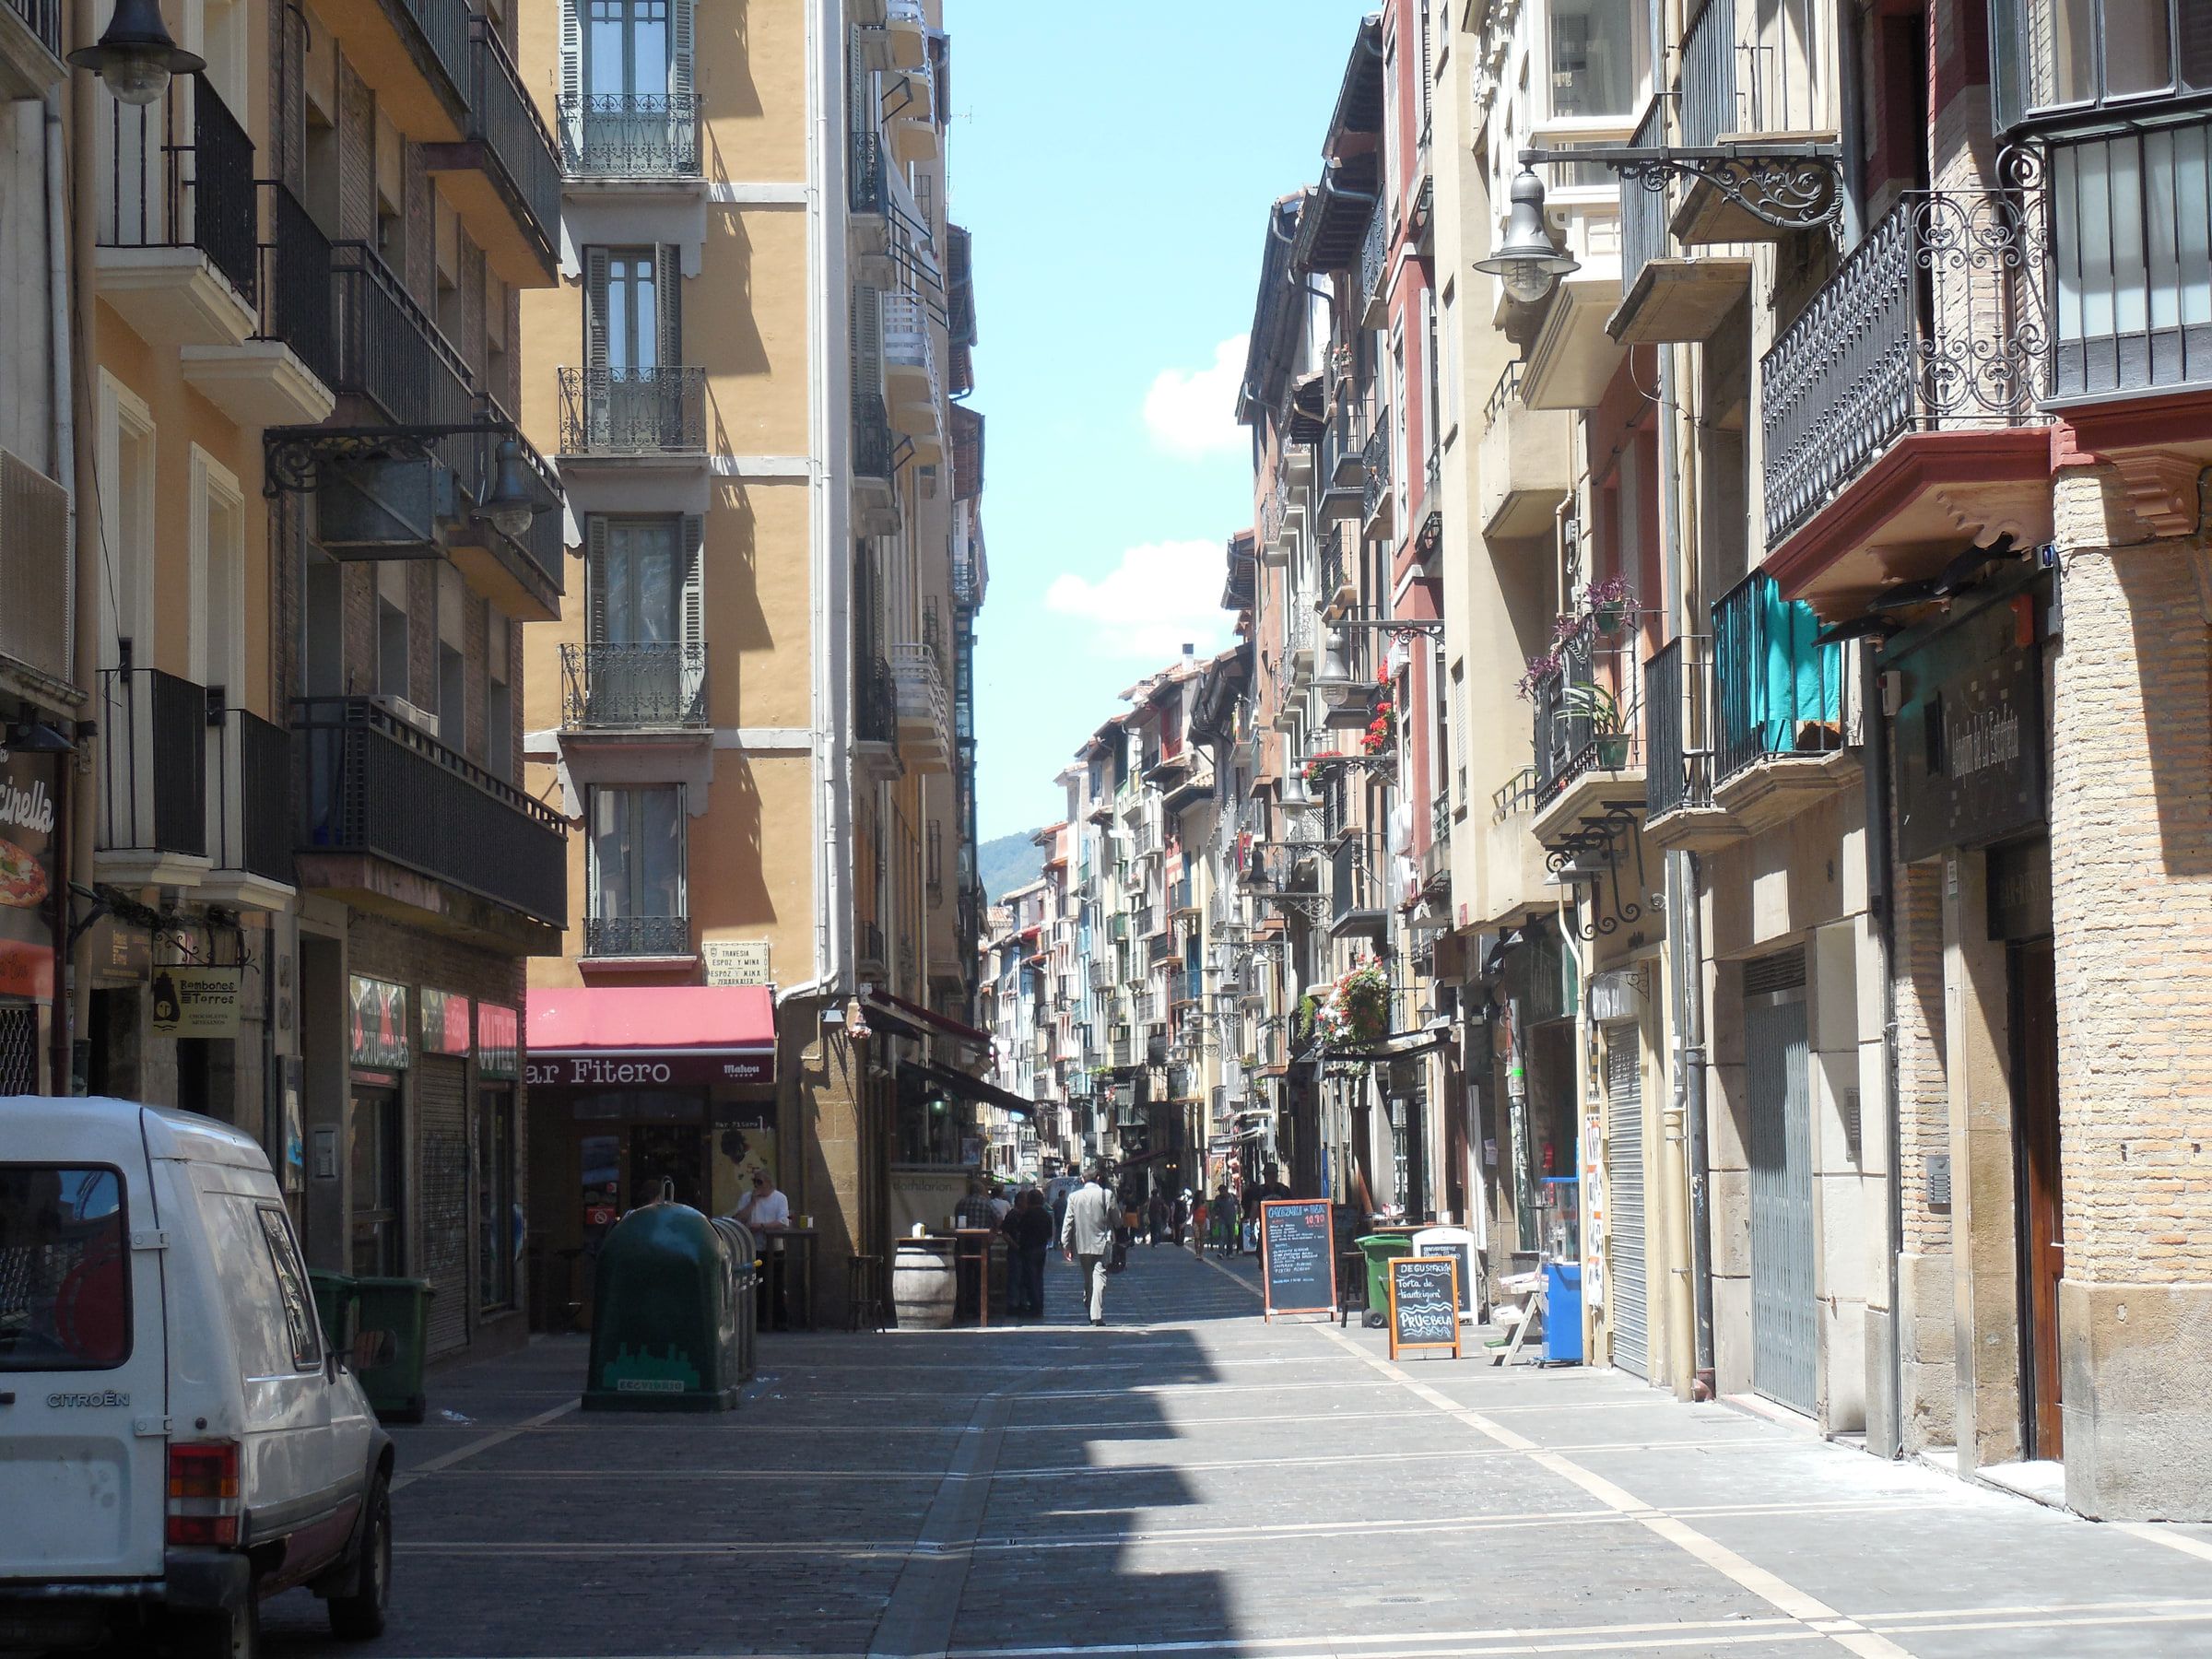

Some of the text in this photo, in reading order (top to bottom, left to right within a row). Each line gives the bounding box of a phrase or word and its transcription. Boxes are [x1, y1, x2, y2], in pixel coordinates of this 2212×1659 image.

[1989, 702, 2018, 771] Estafeta
[179, 980, 235, 991] Bombones
[194, 993, 235, 1005] Torres
[478, 1011, 518, 1072] OUTLET
[526, 1059, 671, 1084] ar Fitero
[724, 1064, 759, 1074] Mahou
[1395, 1277, 1435, 1288] Torta de
[47, 1390, 131, 1408] CITROËN
